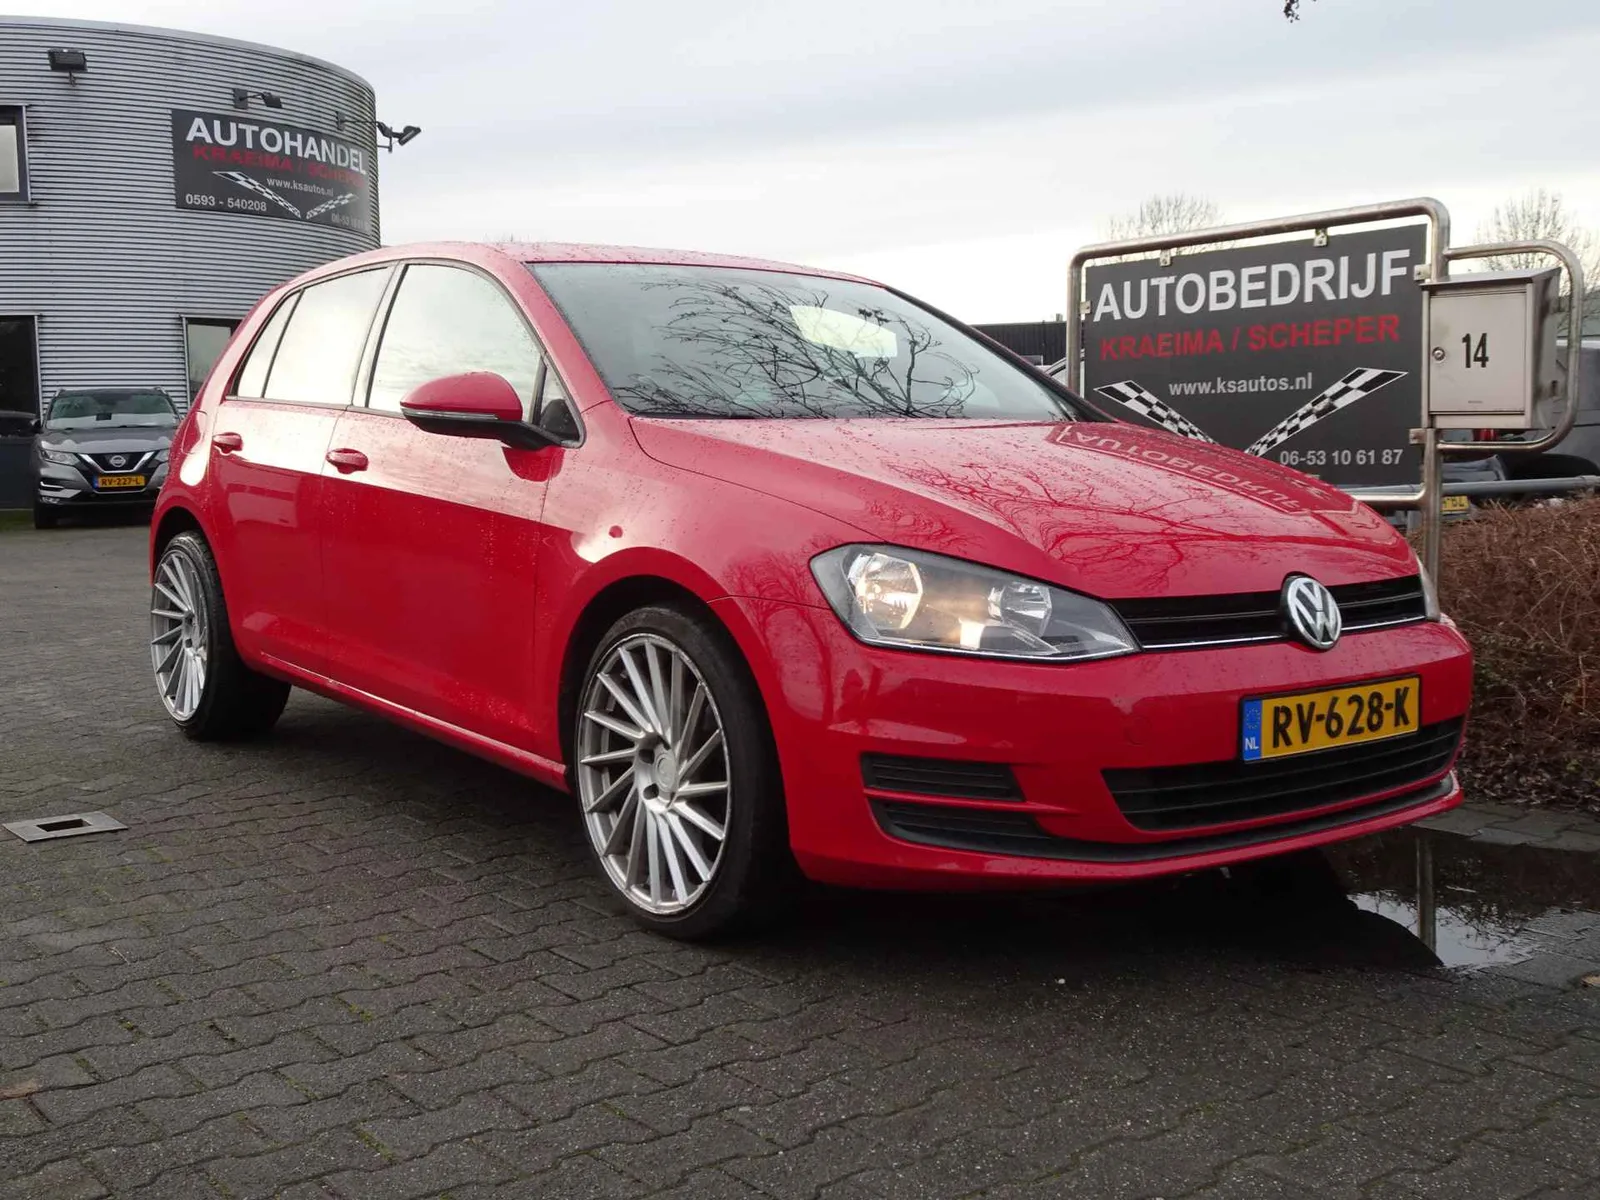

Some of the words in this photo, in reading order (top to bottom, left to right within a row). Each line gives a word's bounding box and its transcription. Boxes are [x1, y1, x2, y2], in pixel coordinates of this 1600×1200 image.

[186, 117, 366, 175] AUTOHANDEL
[193, 145, 294, 173] KRAEIMA
[266, 177, 334, 197] www.ksautos.nl
[186, 194, 215, 206] 0593
[227, 197, 267, 212] 540208
[1093, 249, 1410, 322] AUTOBEDRIJF
[1100, 328, 1224, 361] KRAEIMA
[1247, 314, 1400, 351] SCHEPER
[1462, 332, 1489, 368] 14
[1168, 372, 1313, 396] www.ksautos.nl
[1279, 450, 1327, 466] 06-53
[1331, 450, 1351, 465] 10
[1355, 450, 1375, 465] 61
[1381, 449, 1404, 465] 87
[101, 477, 140, 486] RV-227-L
[1272, 687, 1410, 748] RV-628-K
[1244, 738, 1259, 750] NL
